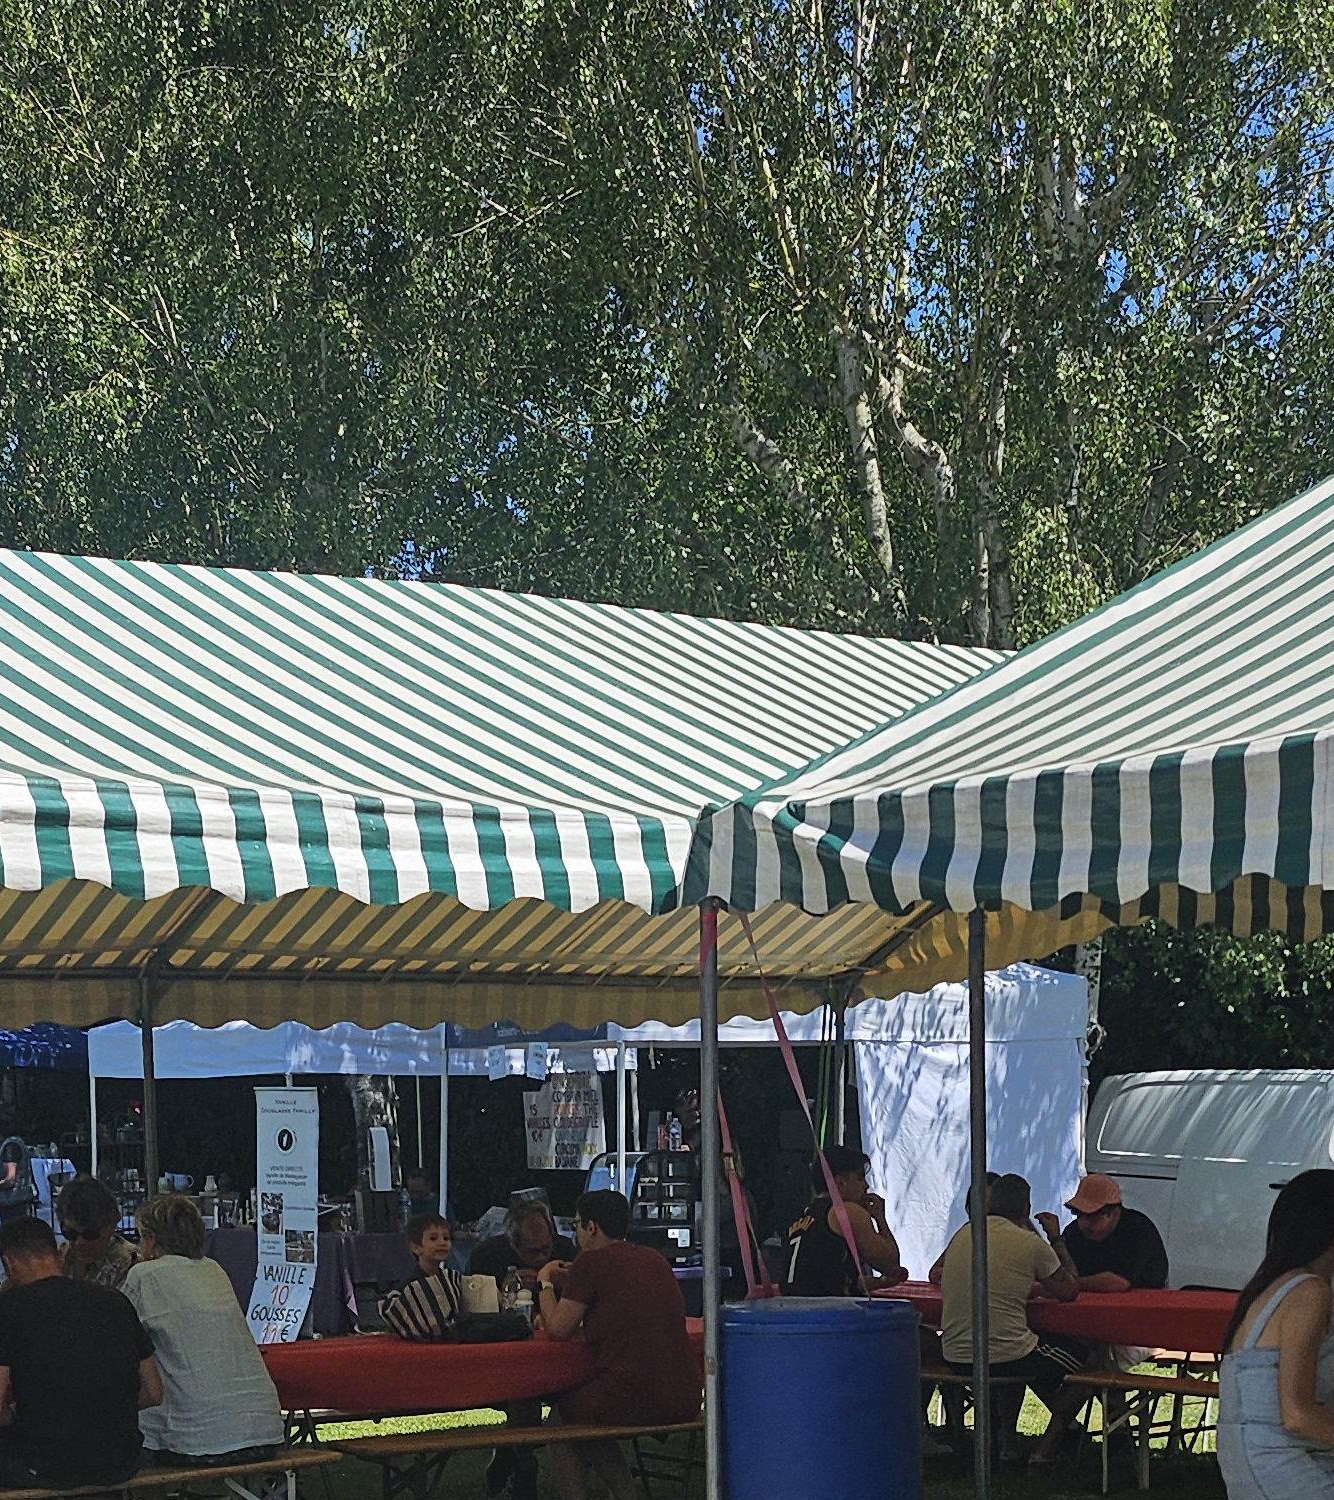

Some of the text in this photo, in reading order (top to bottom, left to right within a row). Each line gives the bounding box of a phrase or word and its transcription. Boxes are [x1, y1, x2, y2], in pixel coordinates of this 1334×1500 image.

[788, 1235, 802, 1283] 7
[264, 1265, 308, 1284] VANILLE
[271, 1284, 289, 1305] 10
[251, 1303, 301, 1324] GOUSSES
